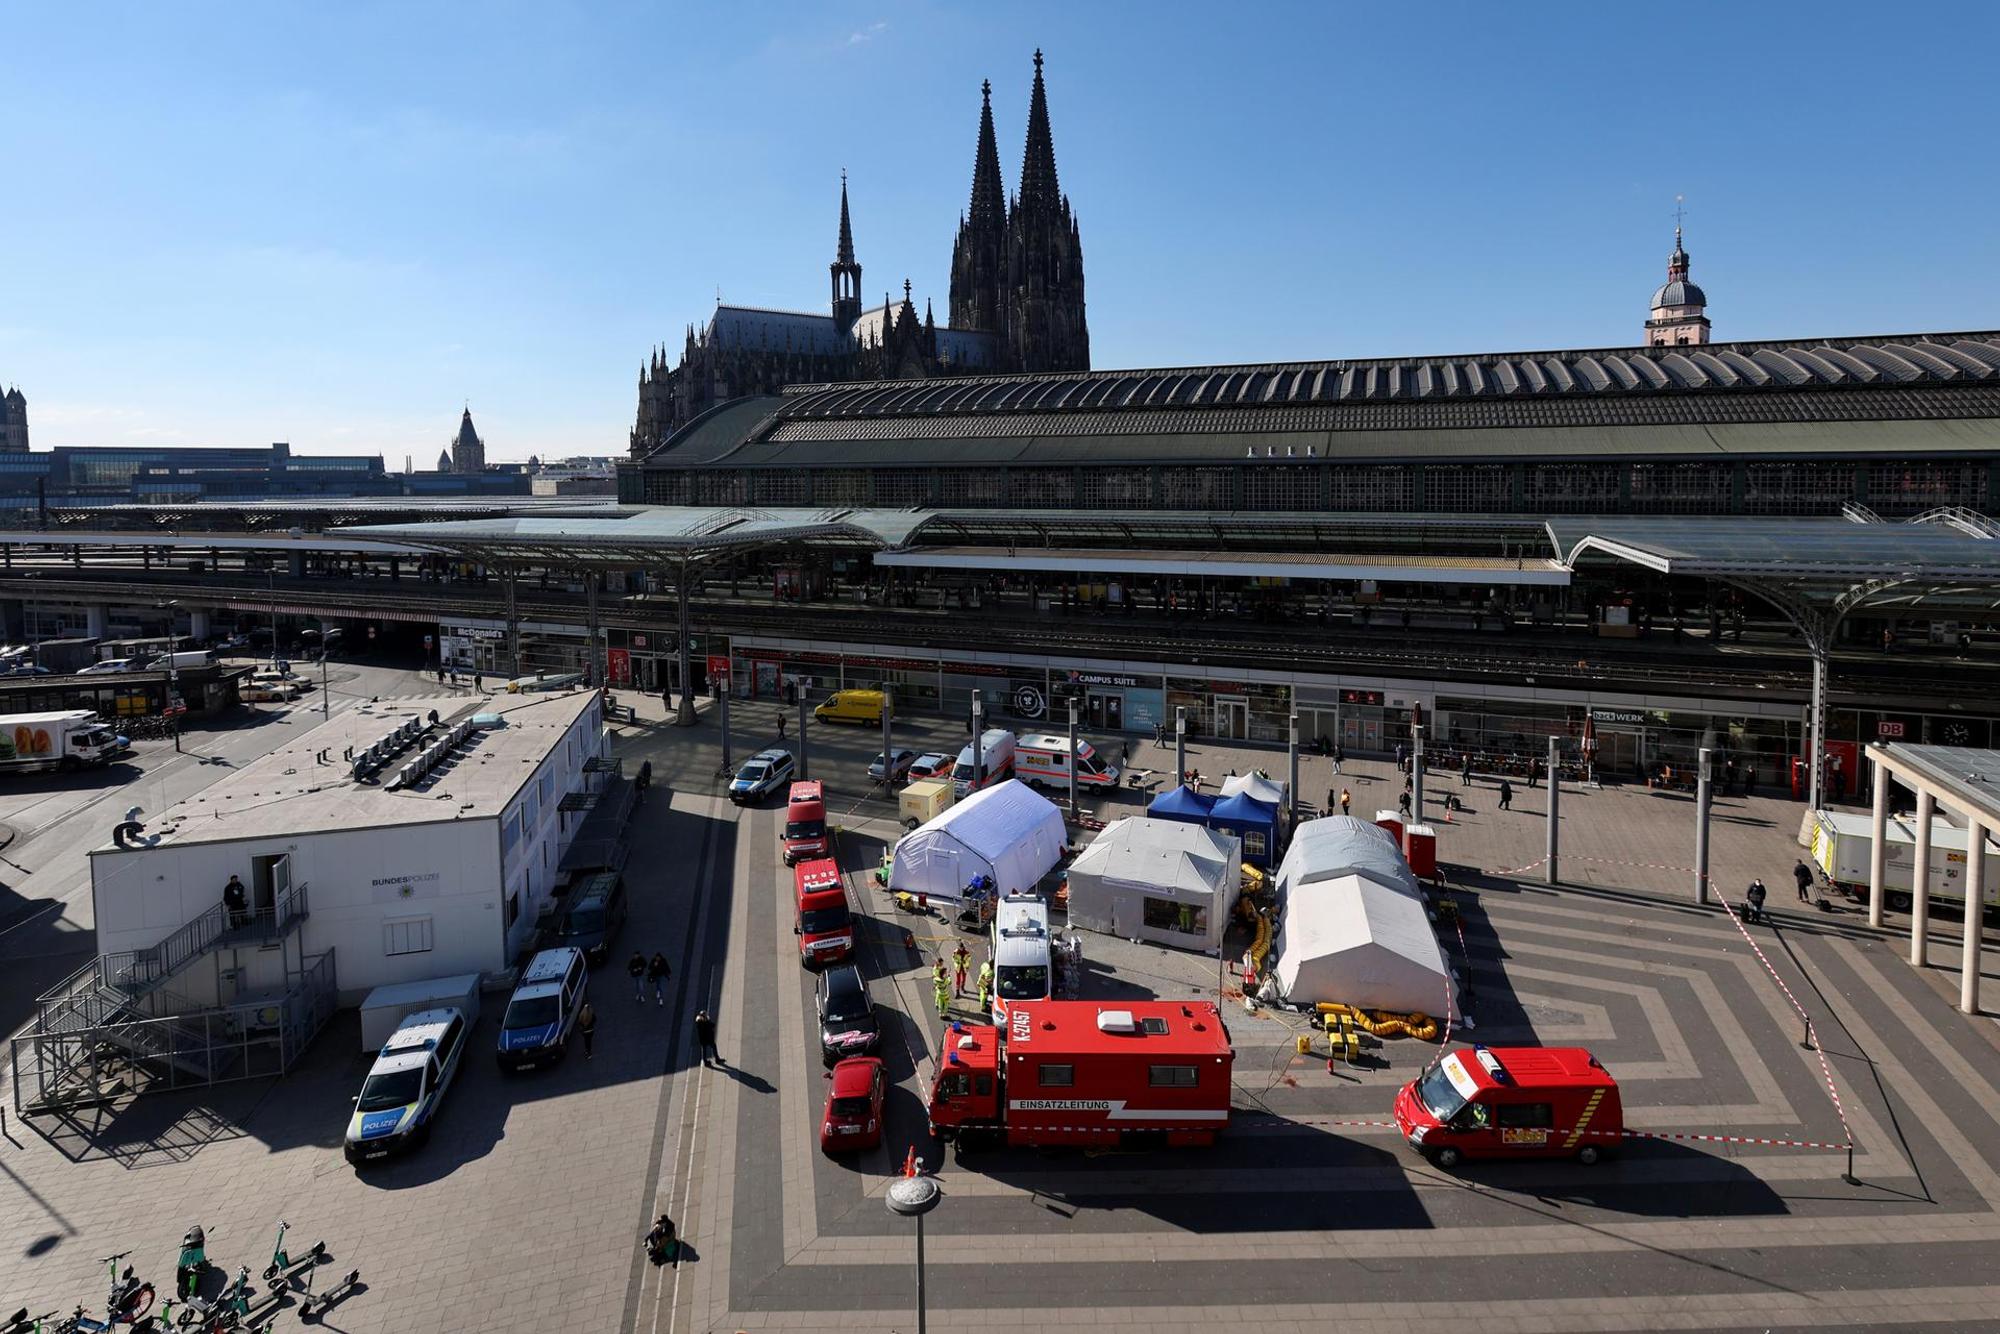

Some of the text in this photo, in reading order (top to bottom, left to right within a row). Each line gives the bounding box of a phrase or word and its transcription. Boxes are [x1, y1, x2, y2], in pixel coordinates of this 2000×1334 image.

[457, 628, 503, 638] McDonald's
[1079, 674, 1137, 687] CAMPUS SUITE
[1880, 723, 1902, 735] DB
[372, 873, 439, 886] BUNDESPOLIZEI
[1013, 1010, 1031, 1041] K-27457
[512, 1035, 541, 1044] POLIZEI
[1020, 1101, 1109, 1109] EINSATZLEITUNG
[363, 1119, 398, 1130] POLIZEI
